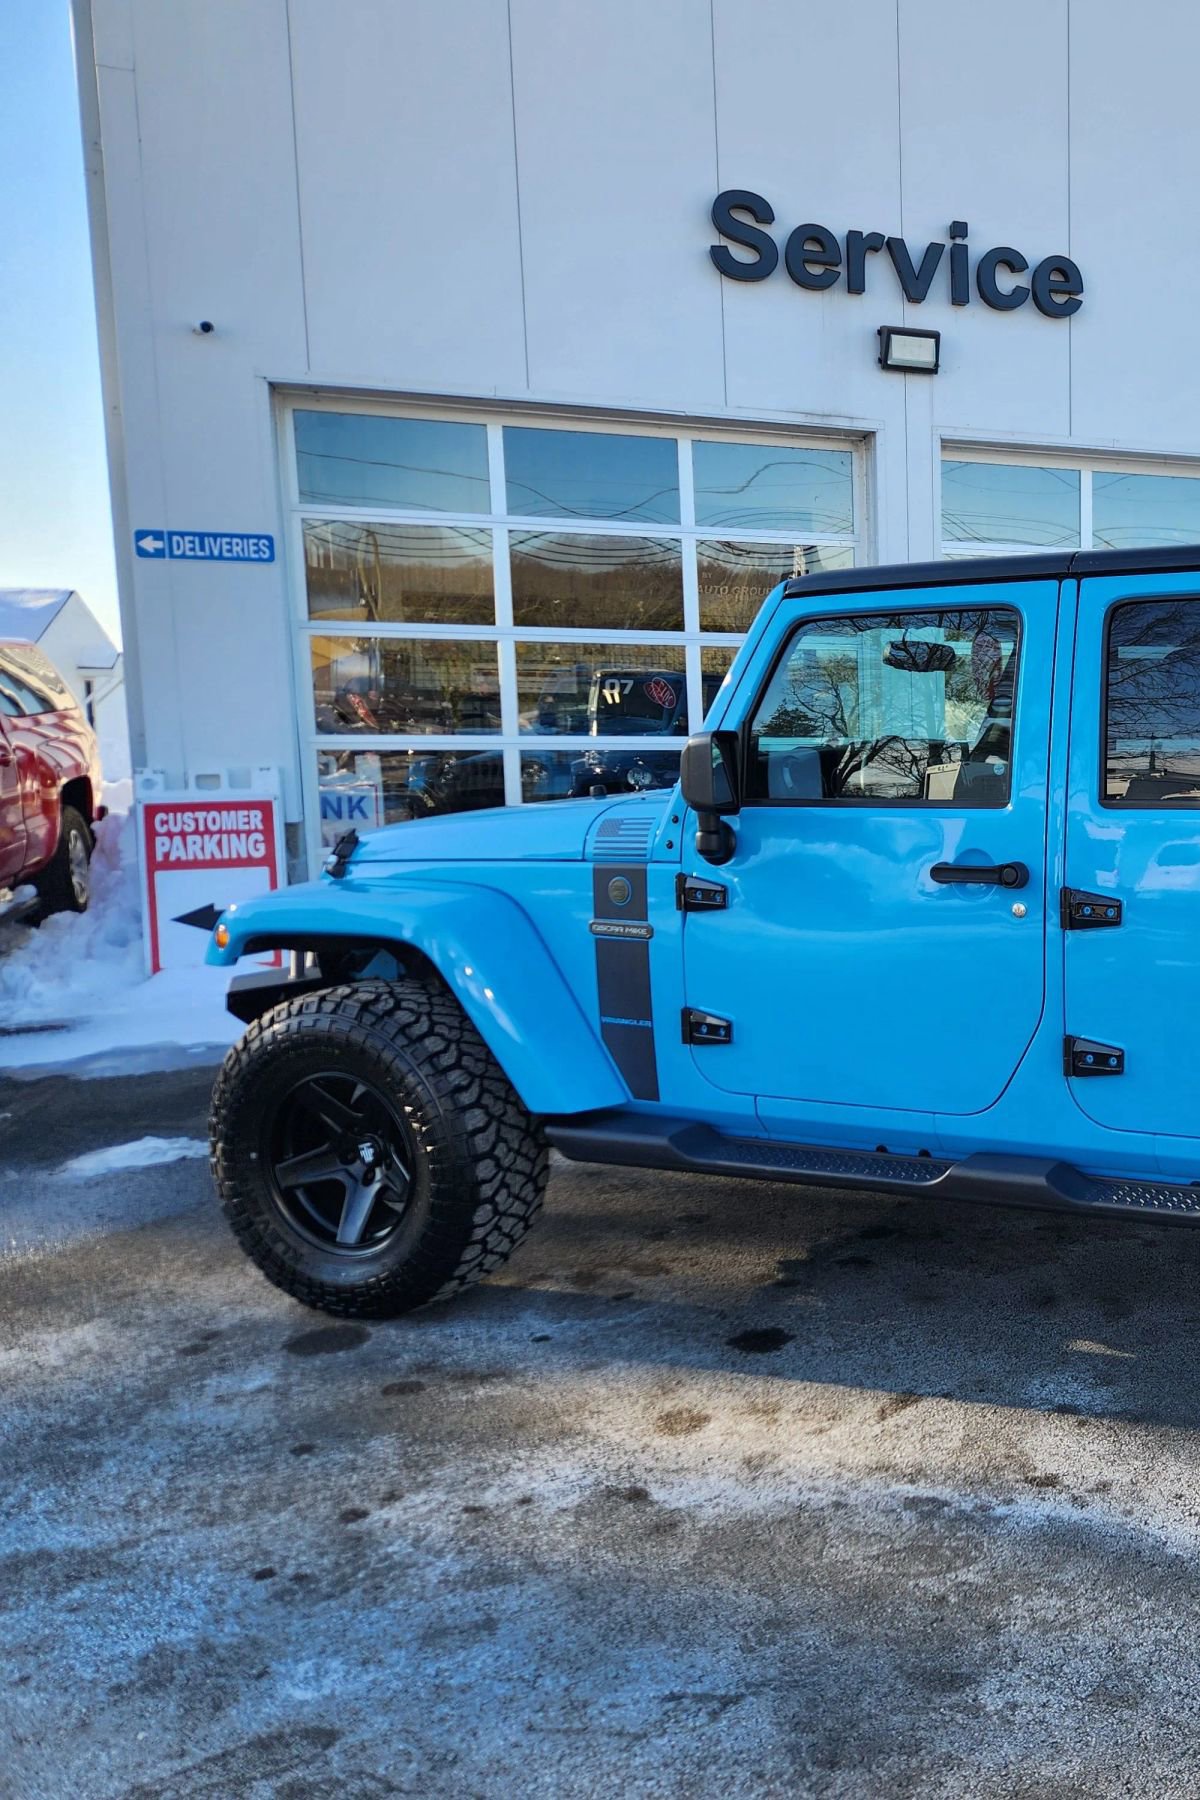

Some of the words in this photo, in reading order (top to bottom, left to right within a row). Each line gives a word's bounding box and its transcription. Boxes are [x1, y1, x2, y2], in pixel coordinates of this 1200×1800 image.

[709, 189, 1084, 318] Service
[171, 535, 270, 559] DELIVERIES
[154, 810, 264, 833] CUSTOMER
[155, 832, 266, 861] PARKING
